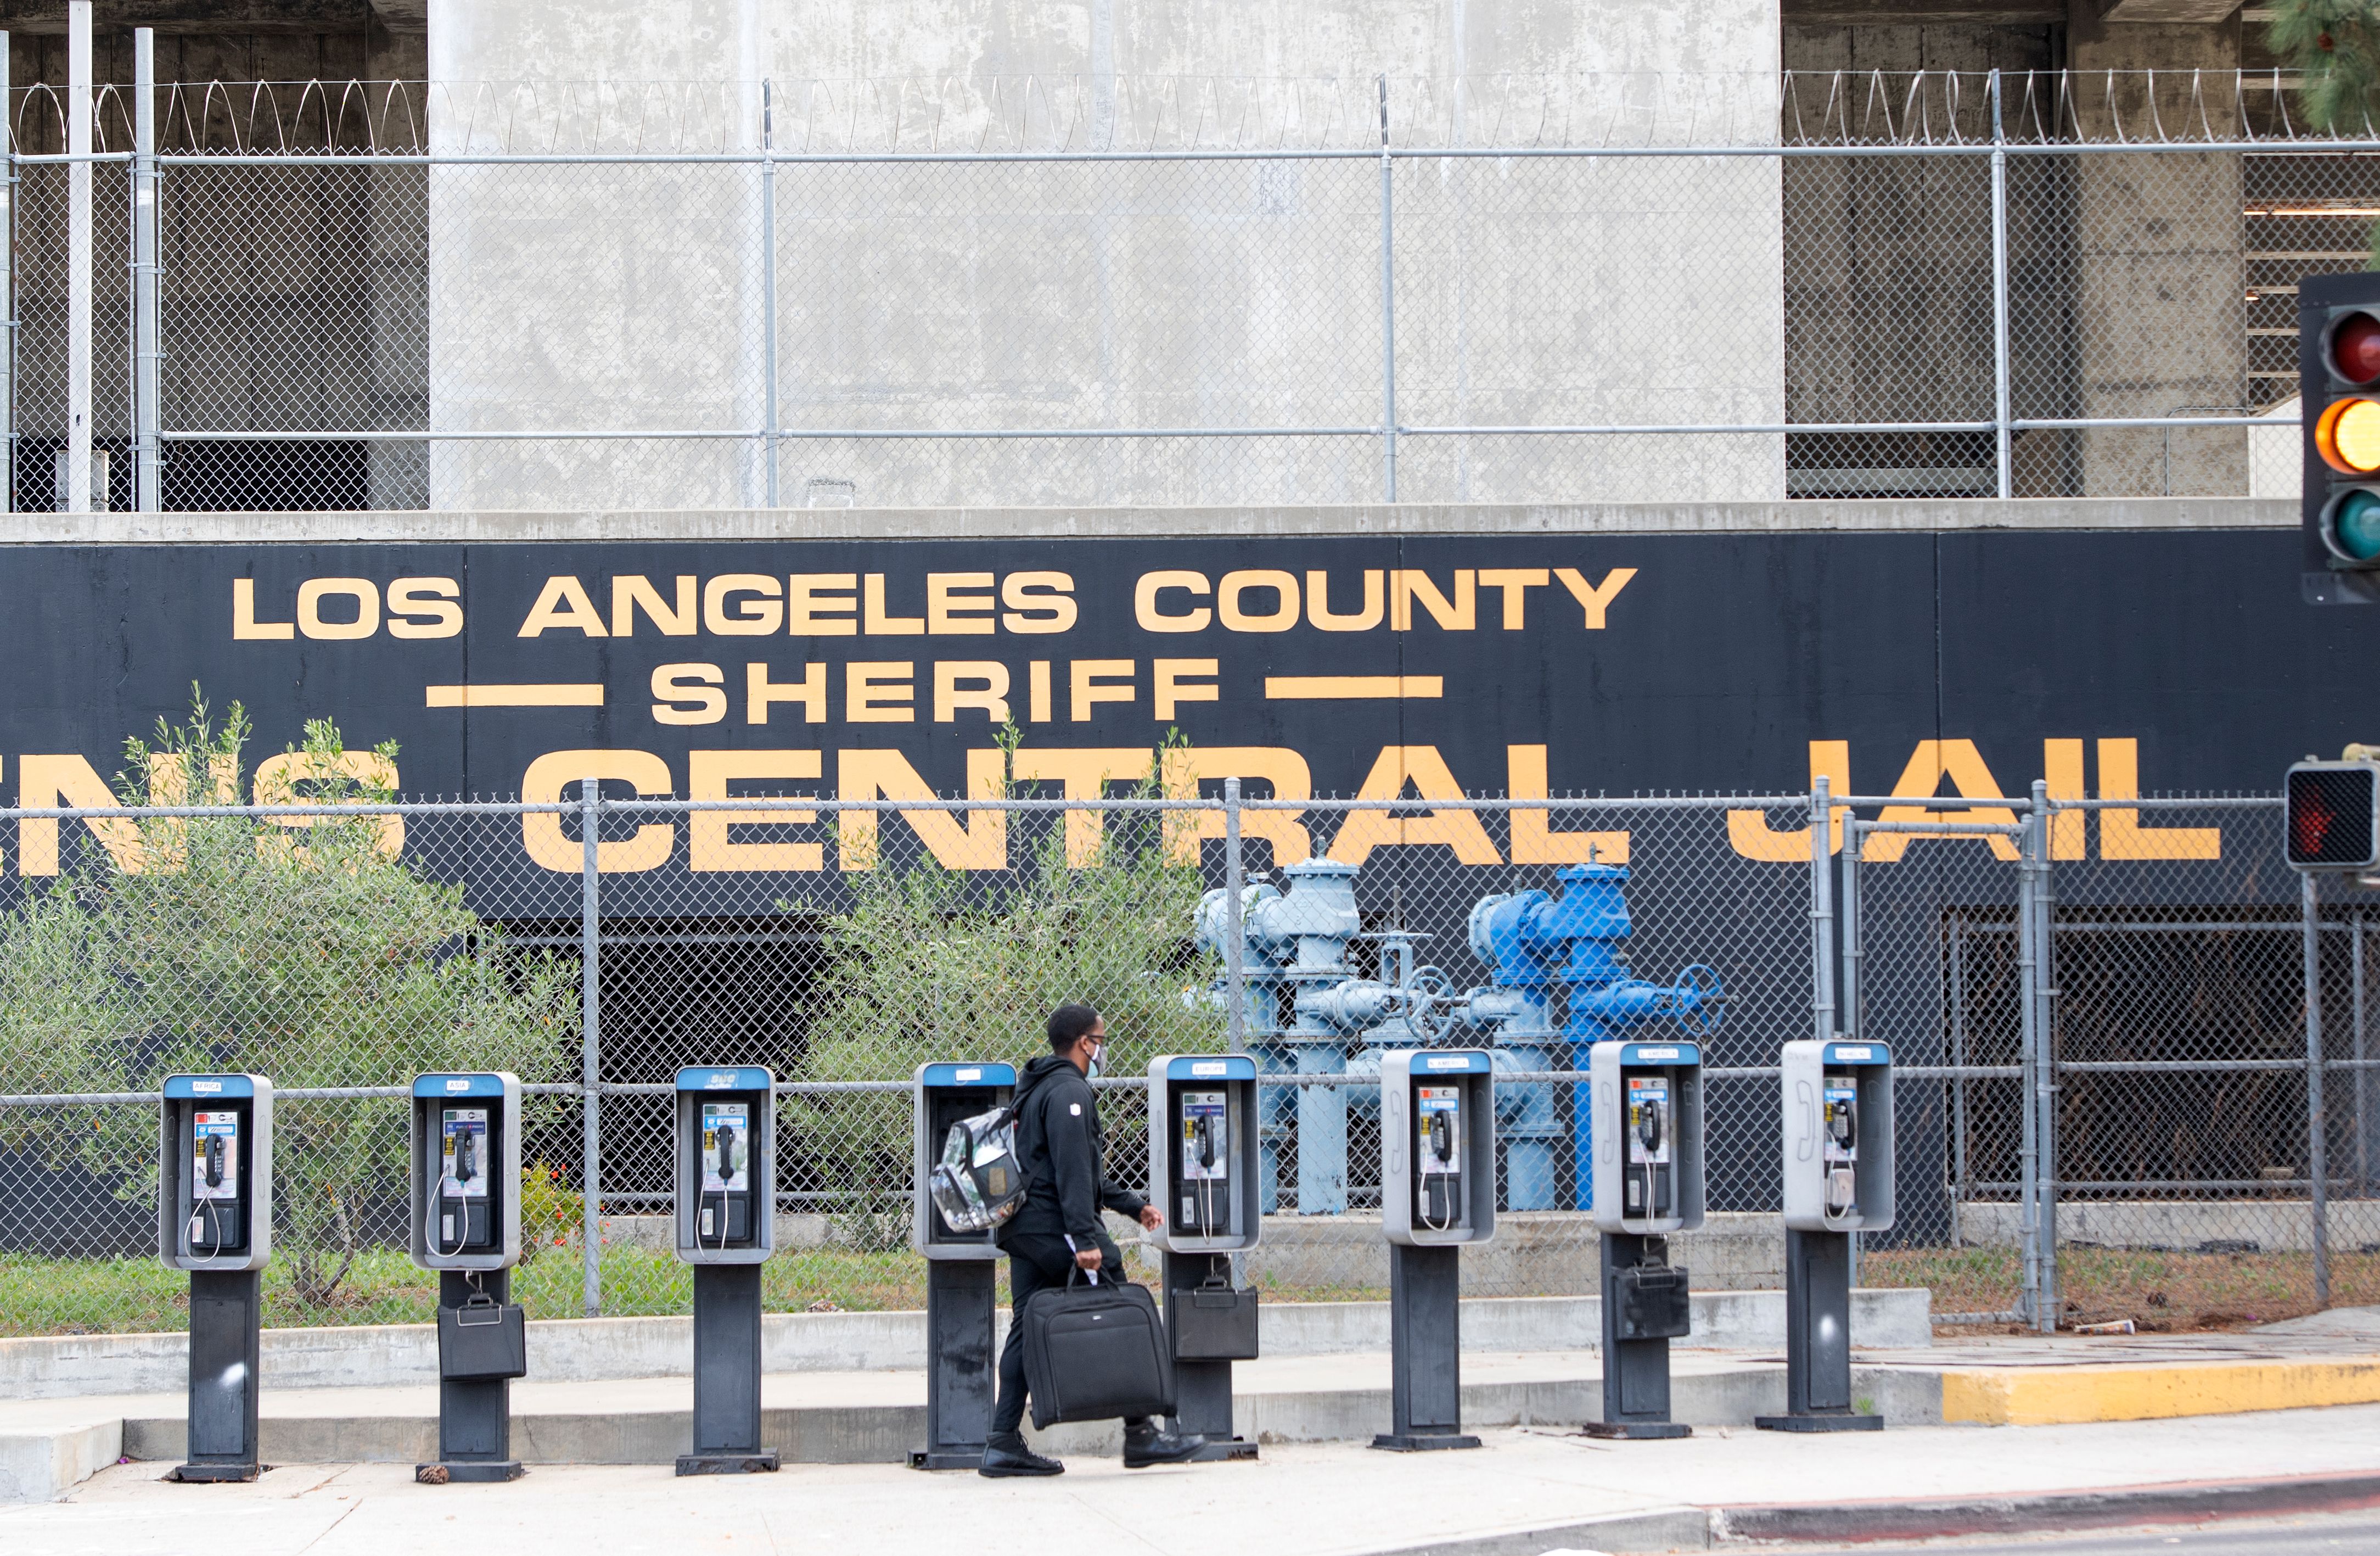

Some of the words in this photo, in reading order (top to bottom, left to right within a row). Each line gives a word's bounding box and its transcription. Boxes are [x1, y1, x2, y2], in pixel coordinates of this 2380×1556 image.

[233, 576, 464, 640] LOS
[518, 570, 1078, 637] ANGELES
[1134, 568, 1638, 633] COUNTY
[652, 658, 1219, 725] SHERIFF
[0, 751, 406, 877] NS
[521, 744, 1630, 873] CENTRAL
[1727, 737, 2220, 862] JAIL
